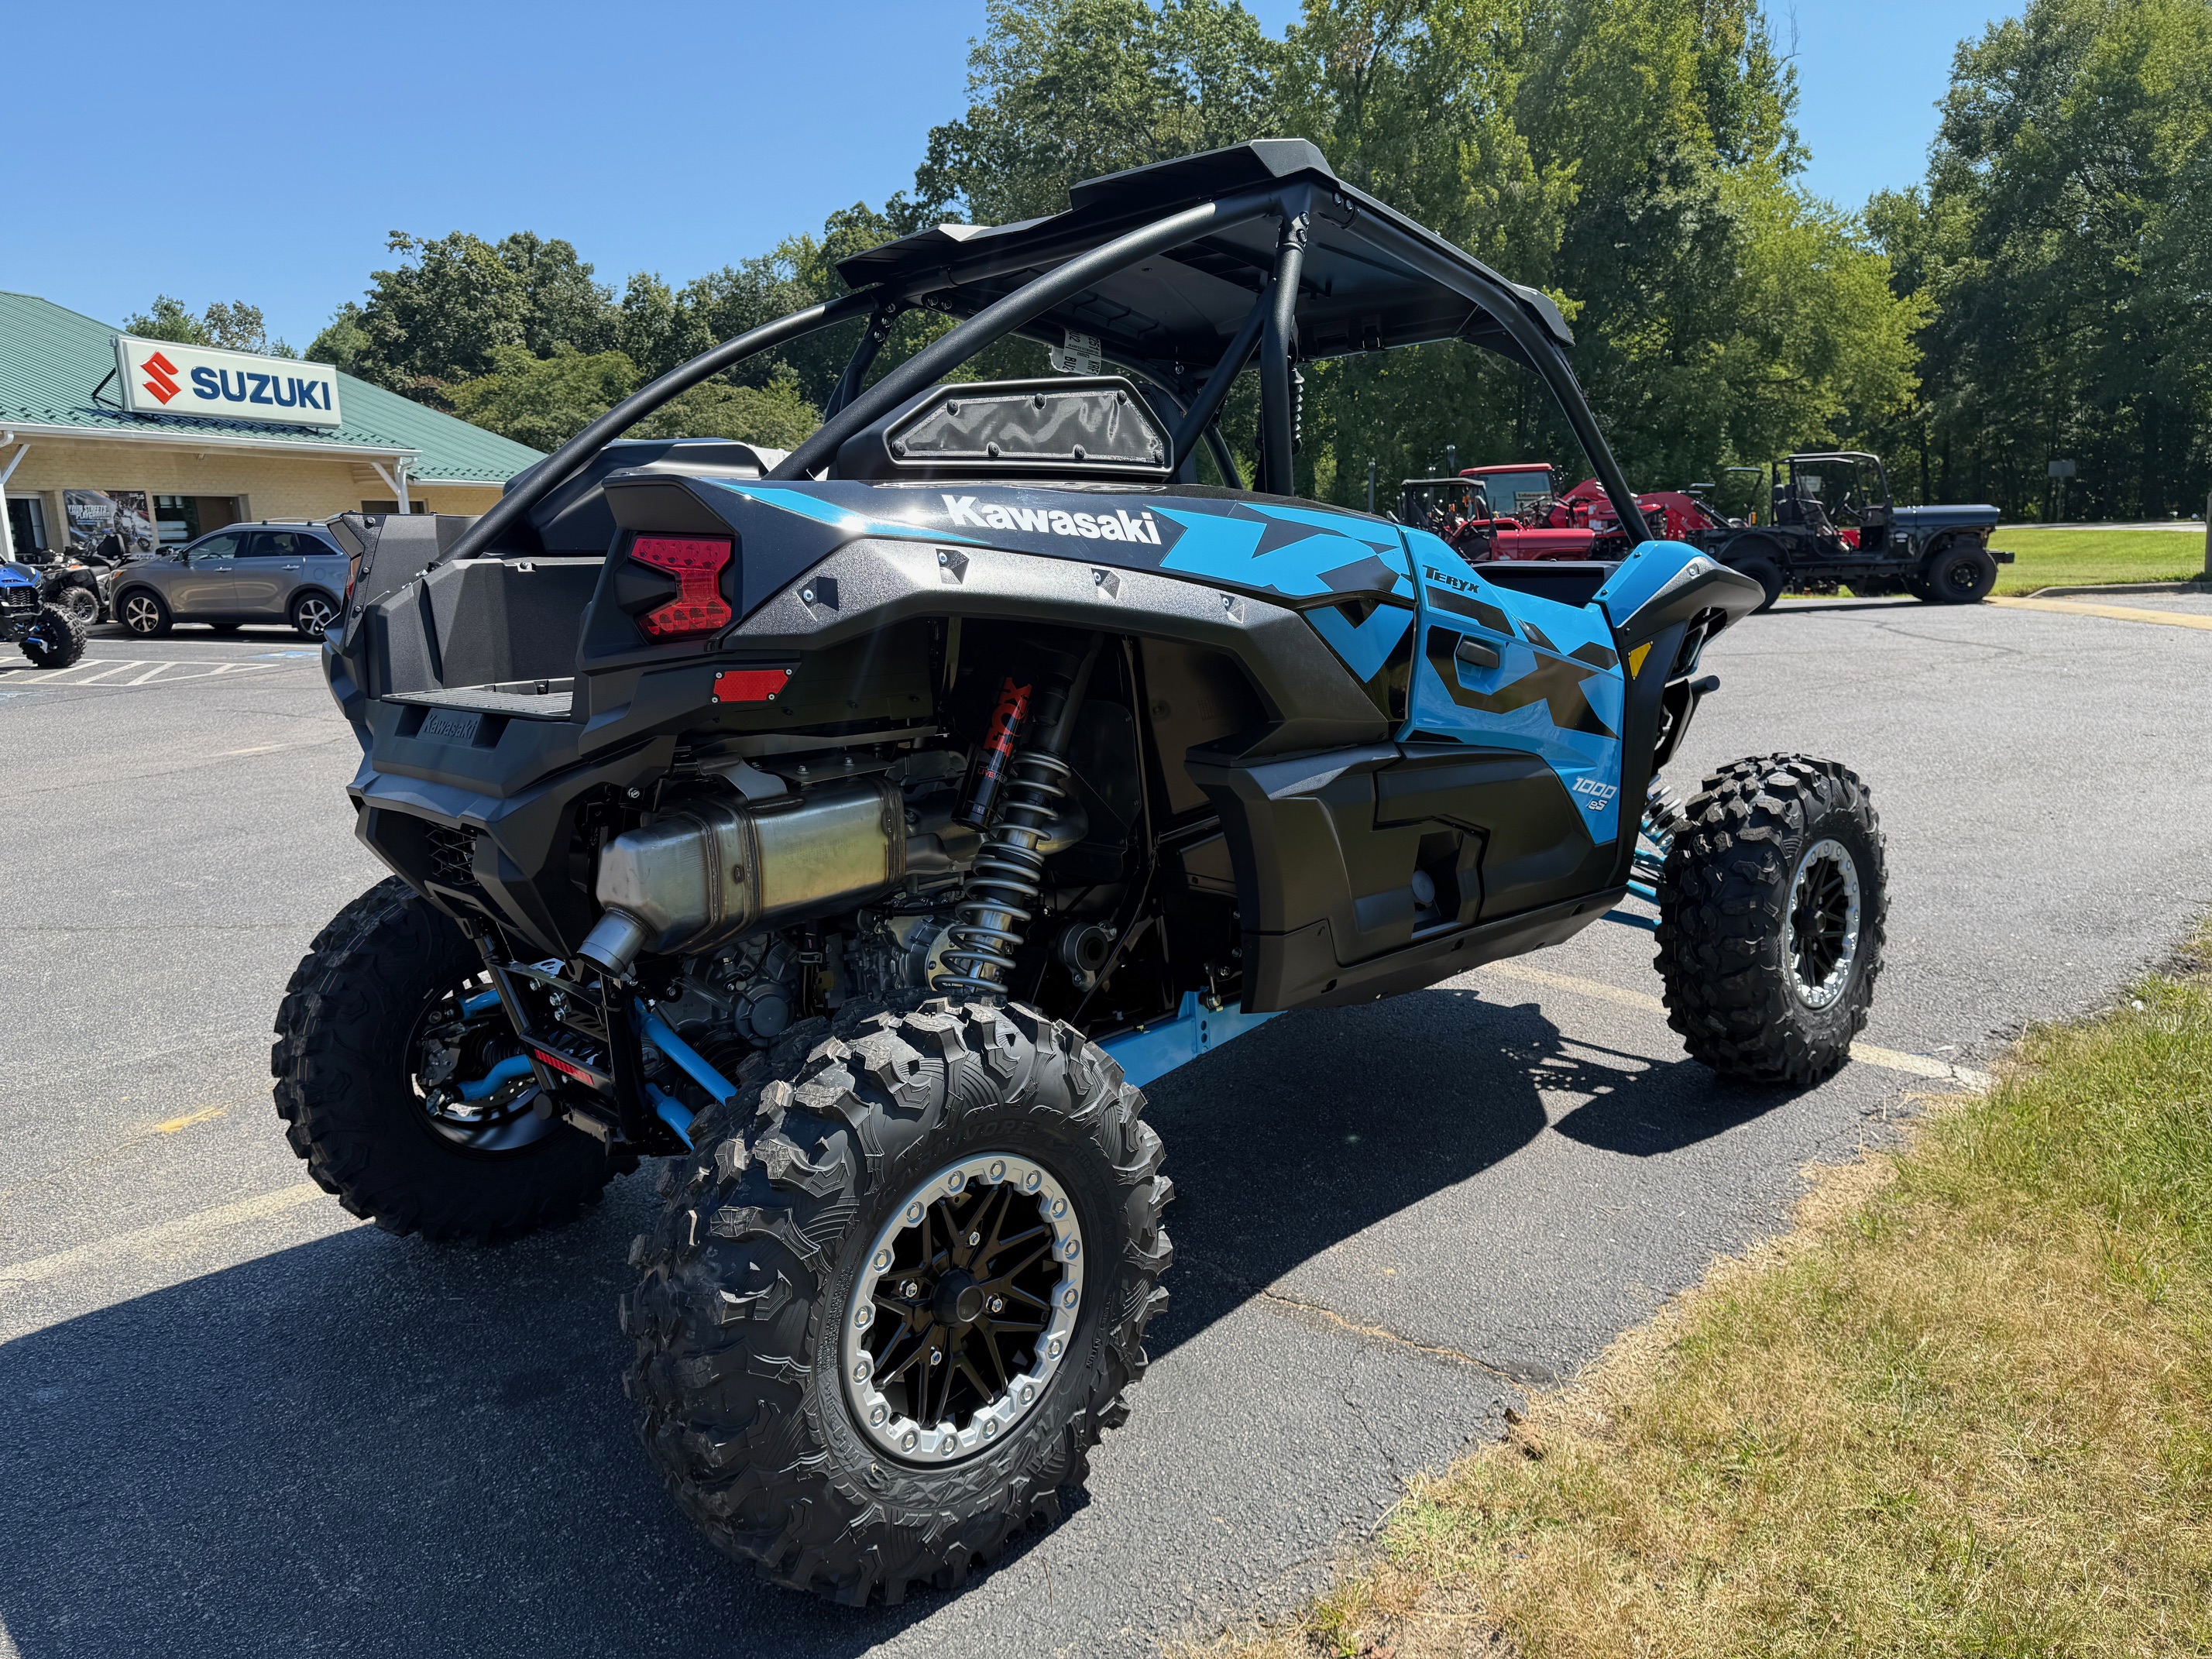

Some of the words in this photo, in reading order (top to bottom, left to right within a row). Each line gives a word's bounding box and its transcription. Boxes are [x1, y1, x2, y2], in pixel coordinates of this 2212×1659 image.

[1062, 356, 1077, 372] BU2
[190, 366, 331, 410] SUZUKI
[941, 494, 1162, 545] Kawasaki
[423, 714, 478, 740] Kawasaki
[983, 676, 1032, 758] FOX
[1571, 777, 1618, 799] 1000
